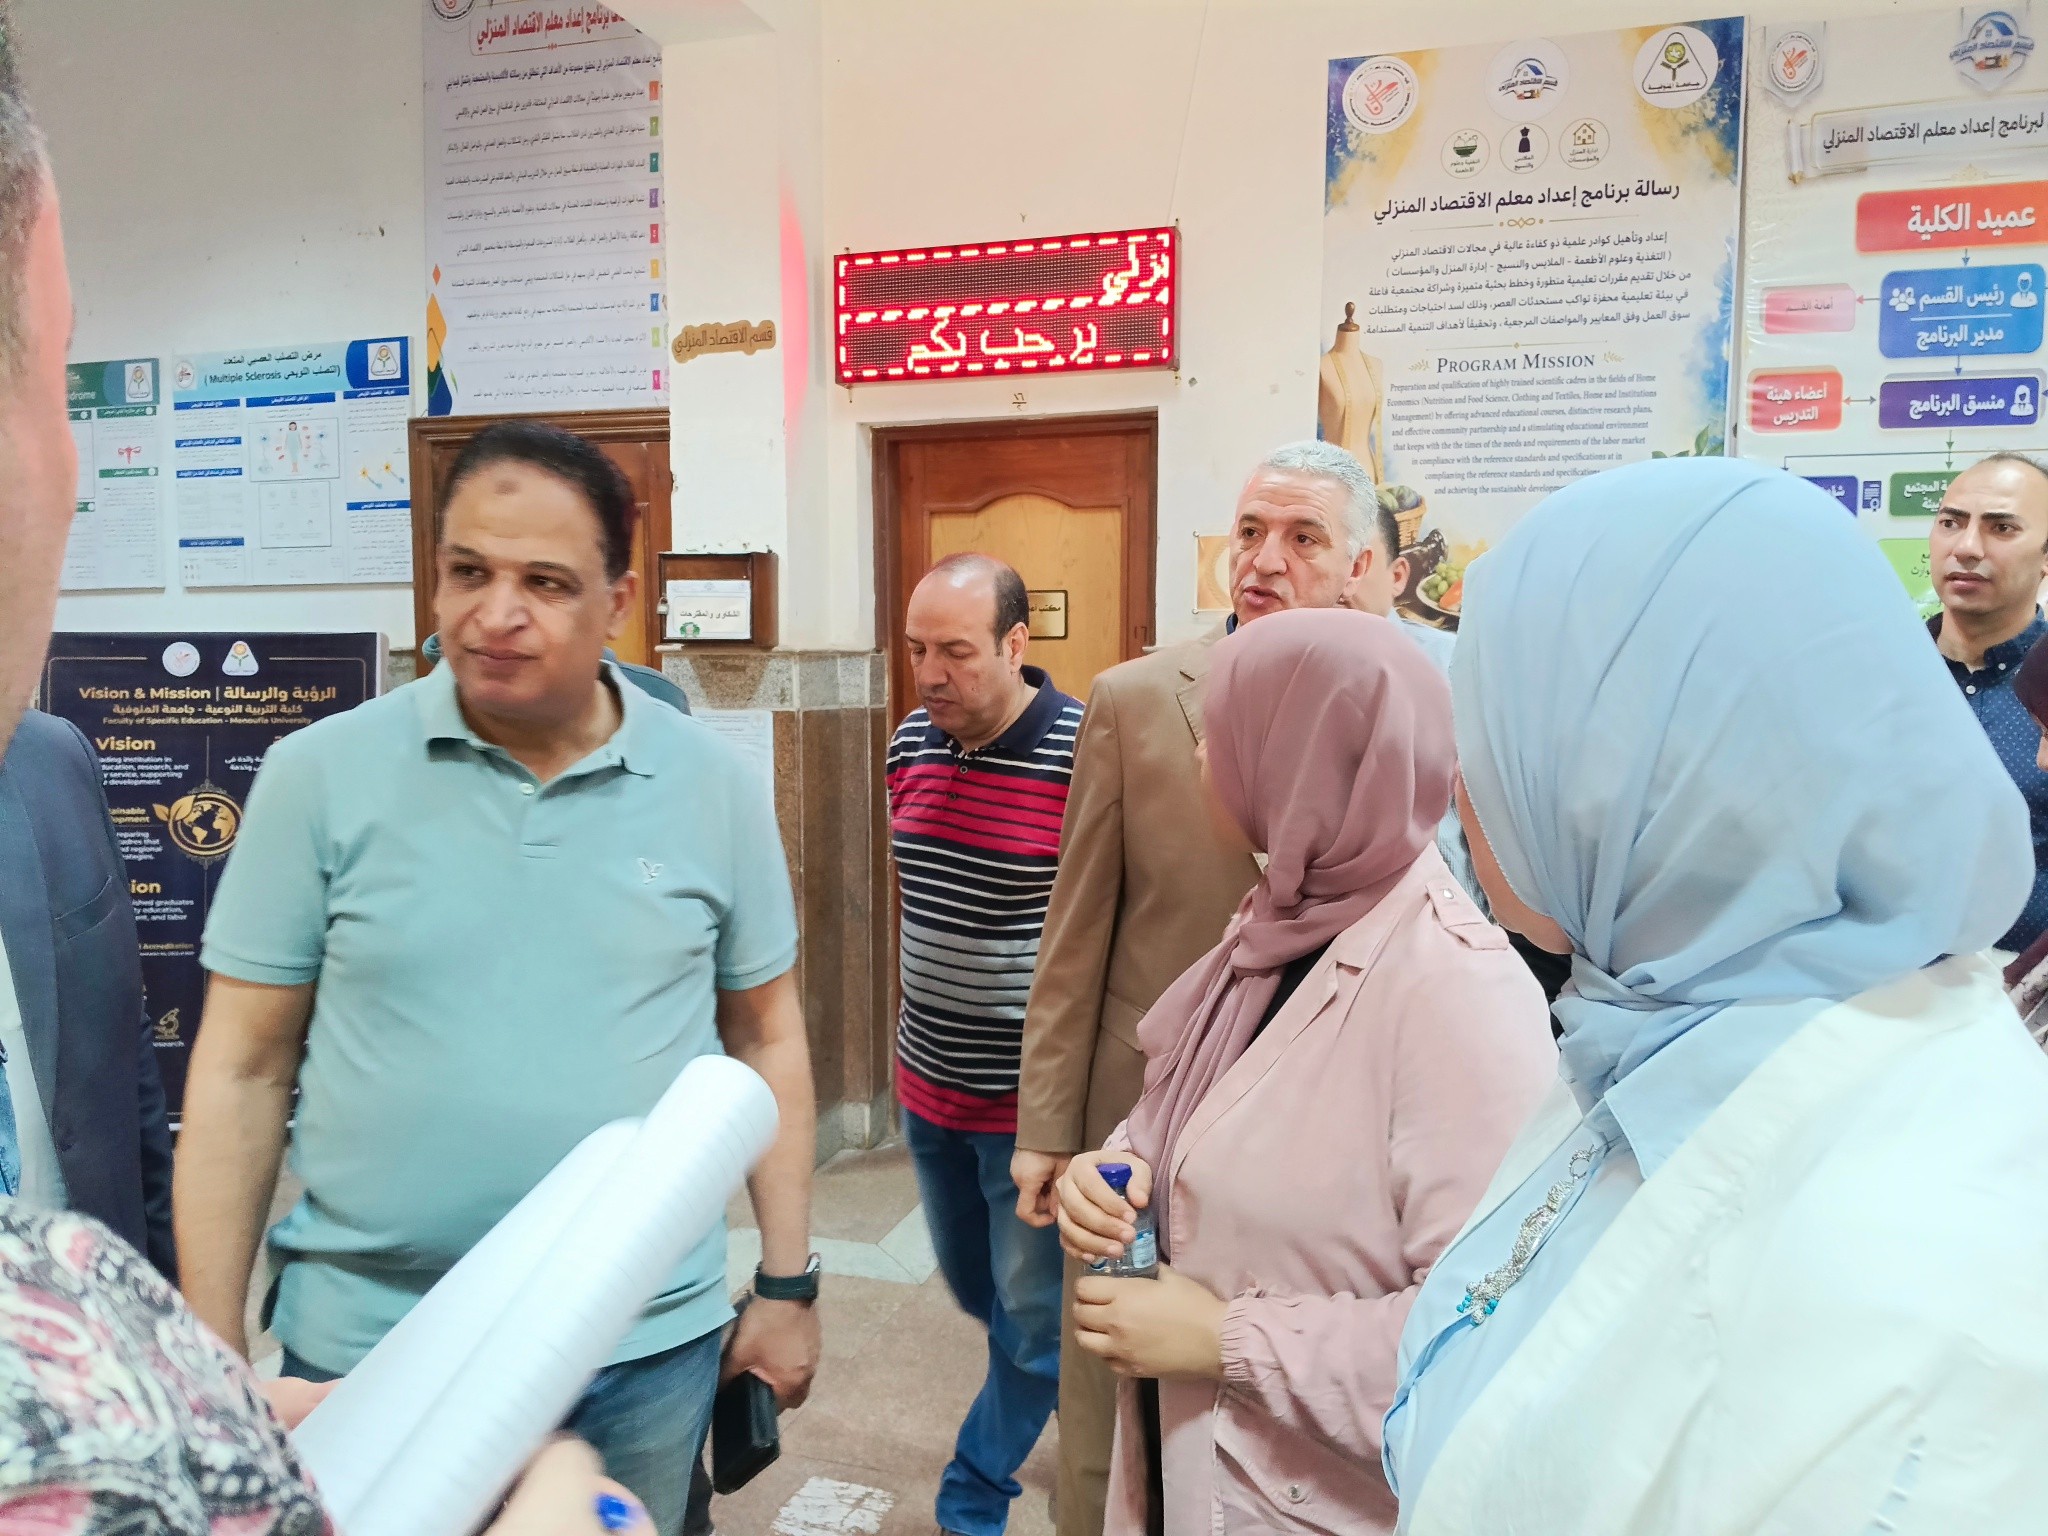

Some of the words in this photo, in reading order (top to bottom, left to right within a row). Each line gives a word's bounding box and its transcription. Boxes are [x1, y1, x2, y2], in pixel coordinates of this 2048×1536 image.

[513, 12, 543, 36] الاقتصاد
[545, 10, 564, 37] معلم
[478, 15, 509, 50] المنزلي
[1868, 122, 1920, 142] الاقتصاد
[1923, 121, 1955, 143] معلم
[1960, 117, 1995, 138] إعداد
[1824, 127, 1864, 153] المنزلي
[1634, 180, 1680, 199] رسالة
[1430, 191, 1492, 212] الاقتصاد
[1496, 190, 1533, 213] معلم
[1537, 186, 1577, 207] إعداد
[1581, 185, 1630, 207] برنامج
[1374, 197, 1426, 224] المنزلي
[1908, 203, 1970, 240] الكلية
[1977, 206, 2036, 236] عميد
[1526, 238, 1548, 248] كفاءة
[1563, 236, 1586, 247] علمية
[1589, 235, 1610, 247] كوادر
[1613, 231, 1643, 245] وتأهيل
[1645, 232, 1668, 243] إعداد
[1422, 245, 1455, 256] الاقتصاد
[1457, 244, 1486, 253] مجالات
[1489, 243, 1500, 255] في
[1504, 241, 1523, 250] عالية
[1550, 240, 1560, 249] ذو
[1391, 248, 1420, 262] المنزلي
[1575, 254, 1606, 265] الأطعمة
[1609, 254, 1632, 266] وعلوم
[1636, 251, 1665, 262] التغذية
[1442, 264, 1466, 275] المنزل
[1470, 262, 1487, 272] إدارة
[1497, 260, 1529, 272] والنسيج
[1532, 257, 1564, 270] الملابس
[1391, 265, 1439, 276] والمؤسسات
[1656, 270, 1676, 282] خلال
[1679, 272, 1691, 281] من
[1536, 277, 1565, 288] متطورة
[1567, 276, 1597, 286] تعليمية
[1599, 273, 1628, 284] مقررات
[1630, 271, 1654, 283] تقديم
[1391, 285, 1425, 295] مجتمعية
[1427, 283, 1454, 294] وشراكة
[1457, 283, 1483, 293] متميزة
[1485, 281, 1506, 291] بحثية
[1509, 279, 1534, 289] وخطط
[1369, 287, 1388, 296] فاعلة
[1594, 292, 1618, 303] محفزة
[1621, 291, 1653, 301] تعليمية
[1656, 290, 1673, 300] بيئة
[1676, 288, 1688, 303] في
[1967, 287, 2005, 308] رئيس
[1467, 300, 1487, 310] وذلك
[1518, 296, 1563, 307] مستحدثات
[1566, 294, 1590, 304] تواكب
[1919, 287, 1963, 312] القسم
[1369, 304, 1407, 315] ومتطلبات
[1409, 302, 1446, 313] احتياجات
[1450, 301, 1465, 310] لسد
[1540, 314, 1587, 326] والمواصفات
[1590, 313, 1620, 325] المعايير
[1622, 312, 1640, 323] وفق
[1643, 310, 1667, 322] العمل
[1669, 312, 1690, 321] سوق
[1409, 321, 1434, 333] التنمية
[1436, 318, 1465, 331] لأهداف
[710, 327, 747, 345] الاقتصاد
[750, 326, 772, 346] قسم
[908, 310, 966, 370] بكم
[1917, 325, 1967, 351] البرنامج
[1970, 326, 2004, 346] مدير
[675, 331, 707, 356] المنزلي
[1437, 358, 1516, 373] PROGRAM
[1522, 354, 1595, 369] MISSION
[210, 373, 243, 384] Multiple
[246, 370, 281, 381] Sclerosis
[1766, 388, 1791, 402] هيئة
[1795, 383, 1827, 401] أعضاء
[1910, 394, 1959, 419] البرنامج
[1963, 394, 2005, 416] منسق
[1773, 407, 1818, 426] التدريس
[1392, 428, 1403, 436] and
[1432, 426, 1467, 435] community
[1469, 425, 1506, 435] partnership
[1508, 424, 1520, 432] and
[1394, 442, 1405, 451] that
[1407, 443, 1424, 452] keeps
[1426, 442, 1440, 450] with
[1442, 441, 1451, 449] the
[1453, 441, 1463, 449] the
[1484, 440, 1491, 448] of
[1492, 440, 1501, 448] the
[1524, 438, 1535, 447] and
[1582, 437, 1590, 445] of
[1591, 437, 1600, 445] the
[1904, 480, 1940, 498] المجتمع
[716, 611, 740, 619] الشكاوى
[79, 686, 129, 699] Vision
[134, 688, 146, 699] &
[150, 687, 211, 699] Mission
[224, 686, 288, 702] والرسالة
[292, 686, 336, 702] الرؤية
[162, 704, 195, 716] جامعة
[205, 704, 242, 715] النوعية
[245, 704, 277, 715] التربية
[280, 705, 302, 714] كلية
[95, 736, 156, 751] Vision
